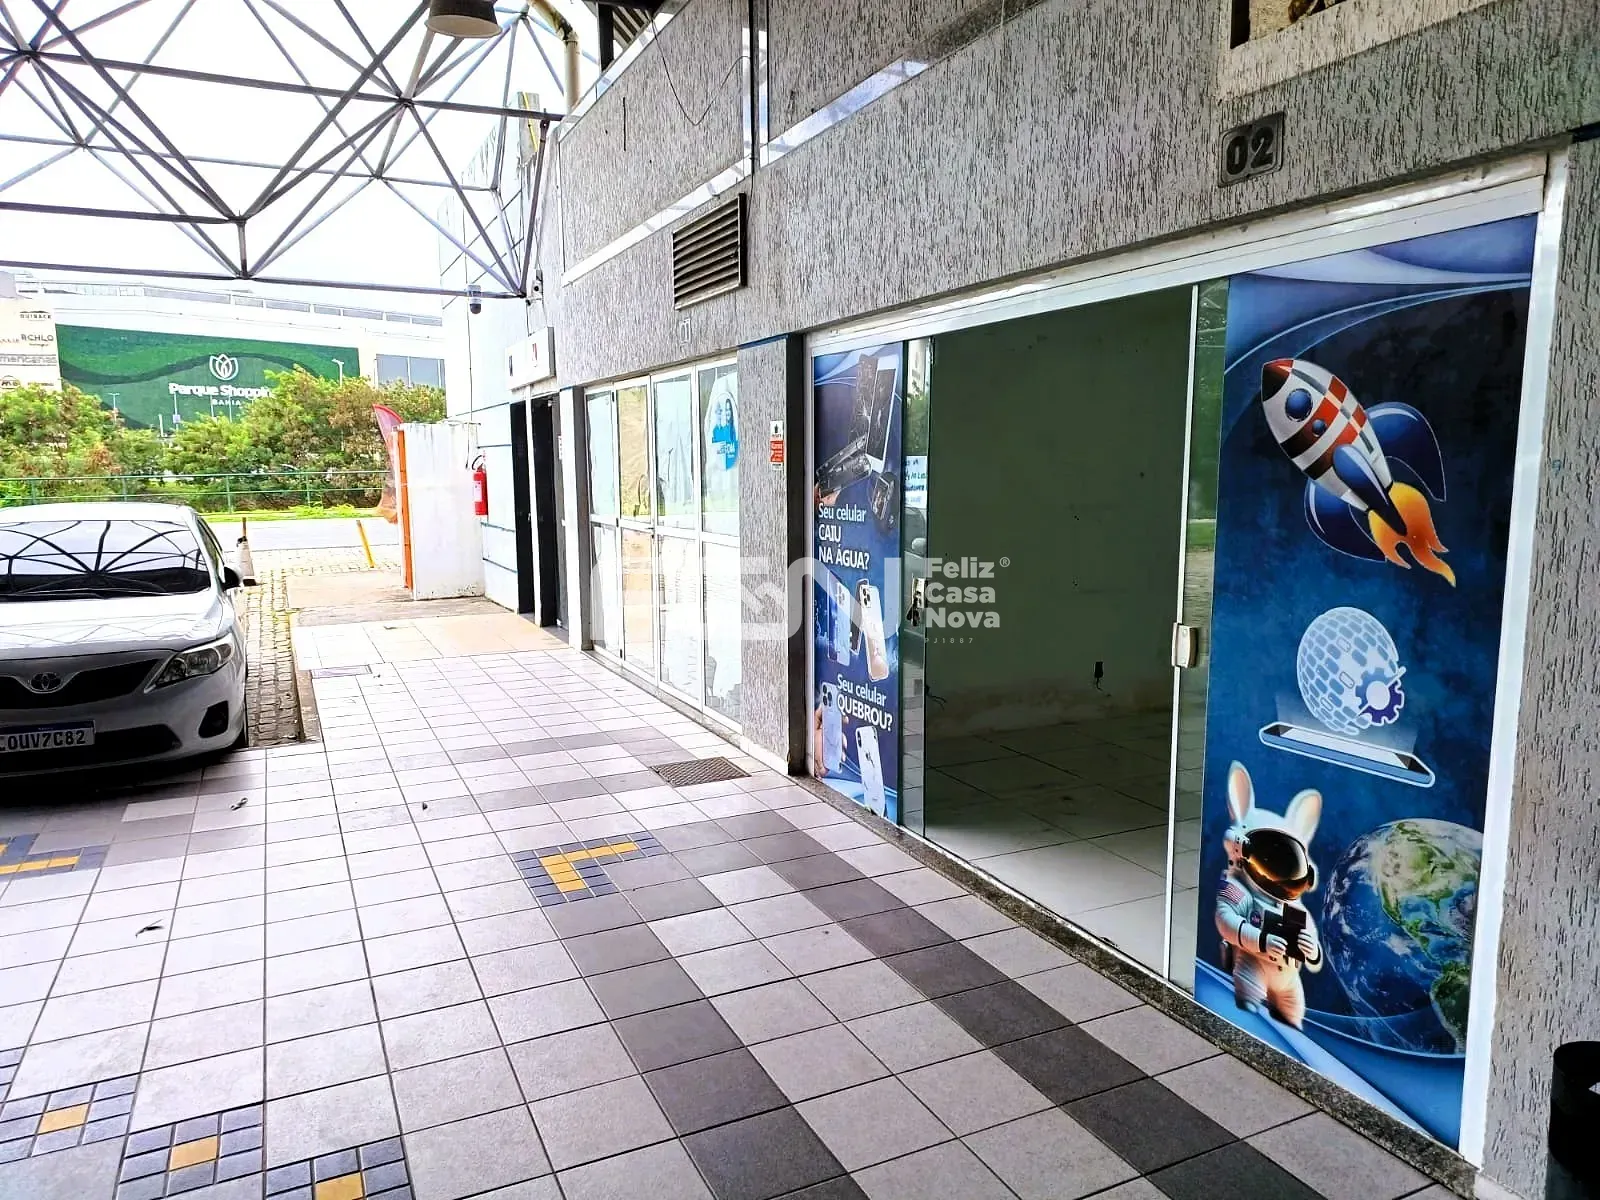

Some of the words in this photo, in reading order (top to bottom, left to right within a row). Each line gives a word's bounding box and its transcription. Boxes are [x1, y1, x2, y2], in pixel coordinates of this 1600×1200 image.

[1227, 126, 1274, 175] 02
[168, 383, 219, 397] Parque
[220, 384, 276, 401] Shoppin
[819, 503, 834, 519] Seu
[836, 504, 867, 522] celular
[818, 524, 841, 542] CAIU
[818, 546, 834, 564] NA
[835, 544, 870, 570] ÁGUA?
[837, 673, 854, 694] Seu
[855, 683, 887, 707] celular
[837, 693, 893, 732] QUEBROU?
[7, 730, 86, 751] OUV7C82
